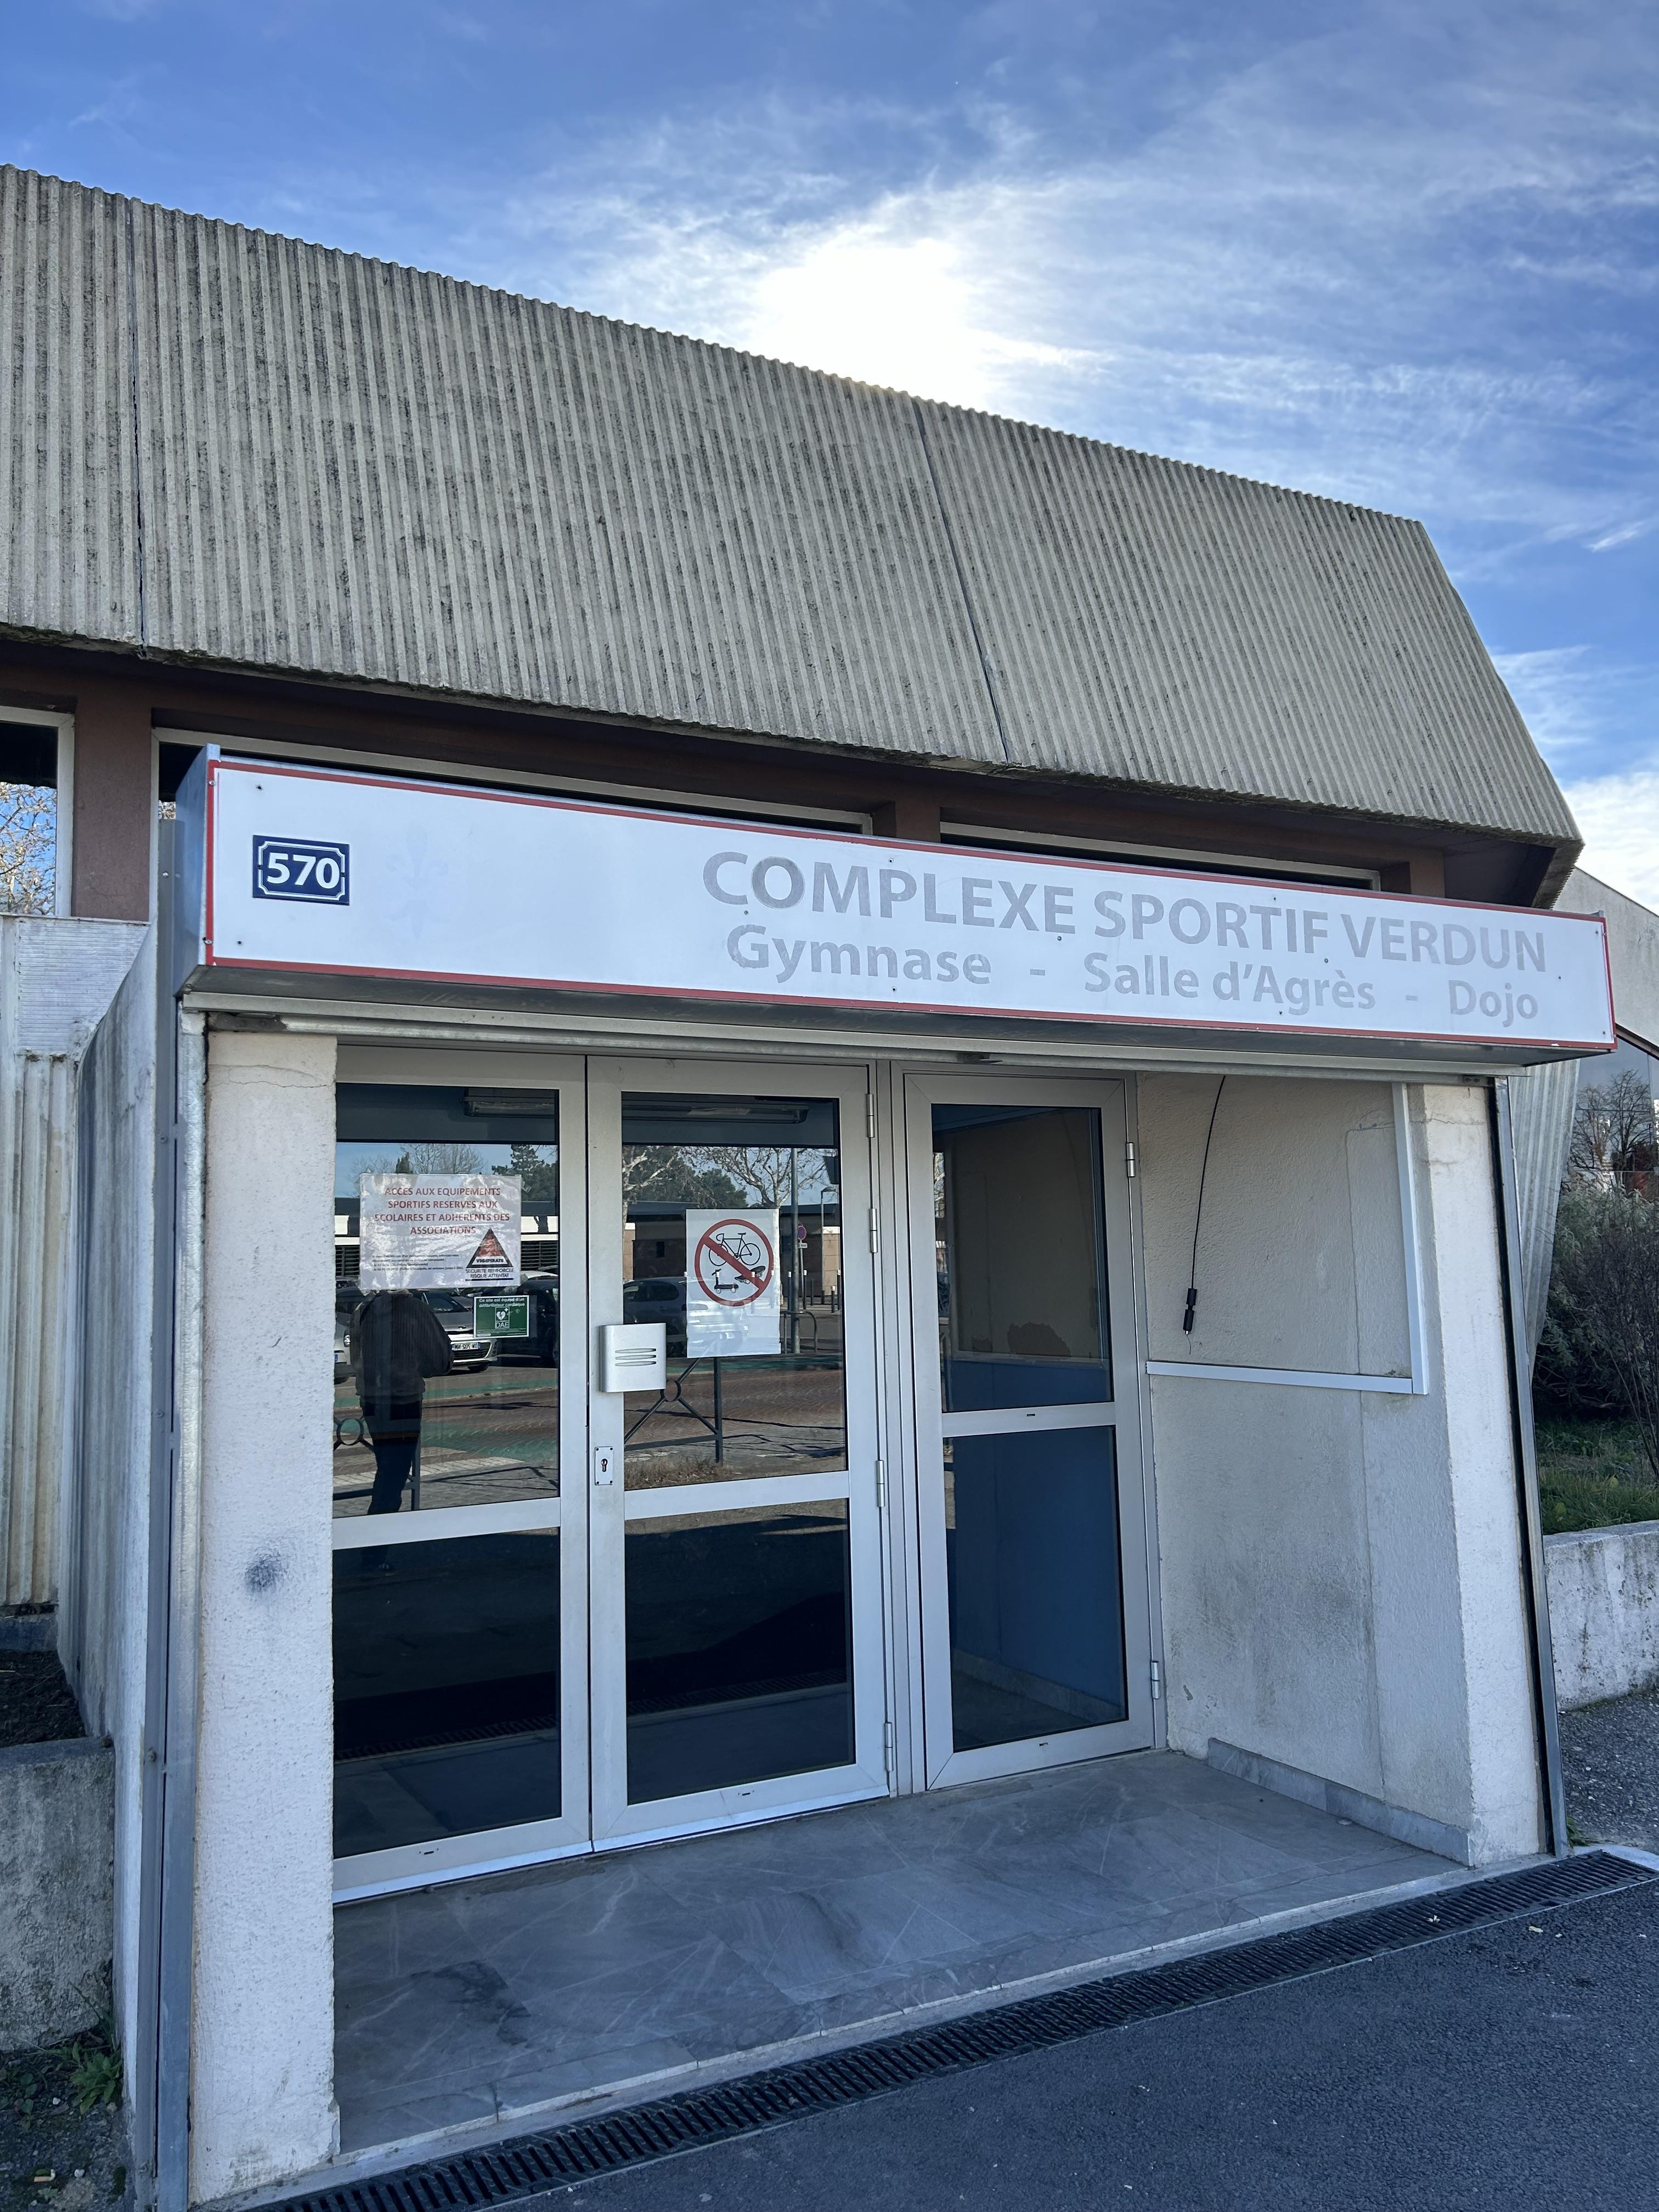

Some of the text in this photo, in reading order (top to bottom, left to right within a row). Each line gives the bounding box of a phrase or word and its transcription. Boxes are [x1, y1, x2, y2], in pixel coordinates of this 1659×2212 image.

[267, 852, 341, 889] 570
[703, 851, 1547, 973] COMPLEXE SPORTIF VERDUN
[726, 924, 991, 984] Gymnase
[1084, 952, 1199, 999] Salle
[1449, 980, 1538, 1028] Dojo
[385, 1187, 501, 1197] ACCES AUX EQUIPEMENTS
[388, 1200, 498, 1209] SPORTIFS RESERVES AUX
[375, 1214, 424, 1222] SCOLAIRES
[426, 1214, 436, 1222] ET
[438, 1213, 492, 1222] ADHERENTS
[410, 1226, 476, 1235] ASSOCIATIONS
